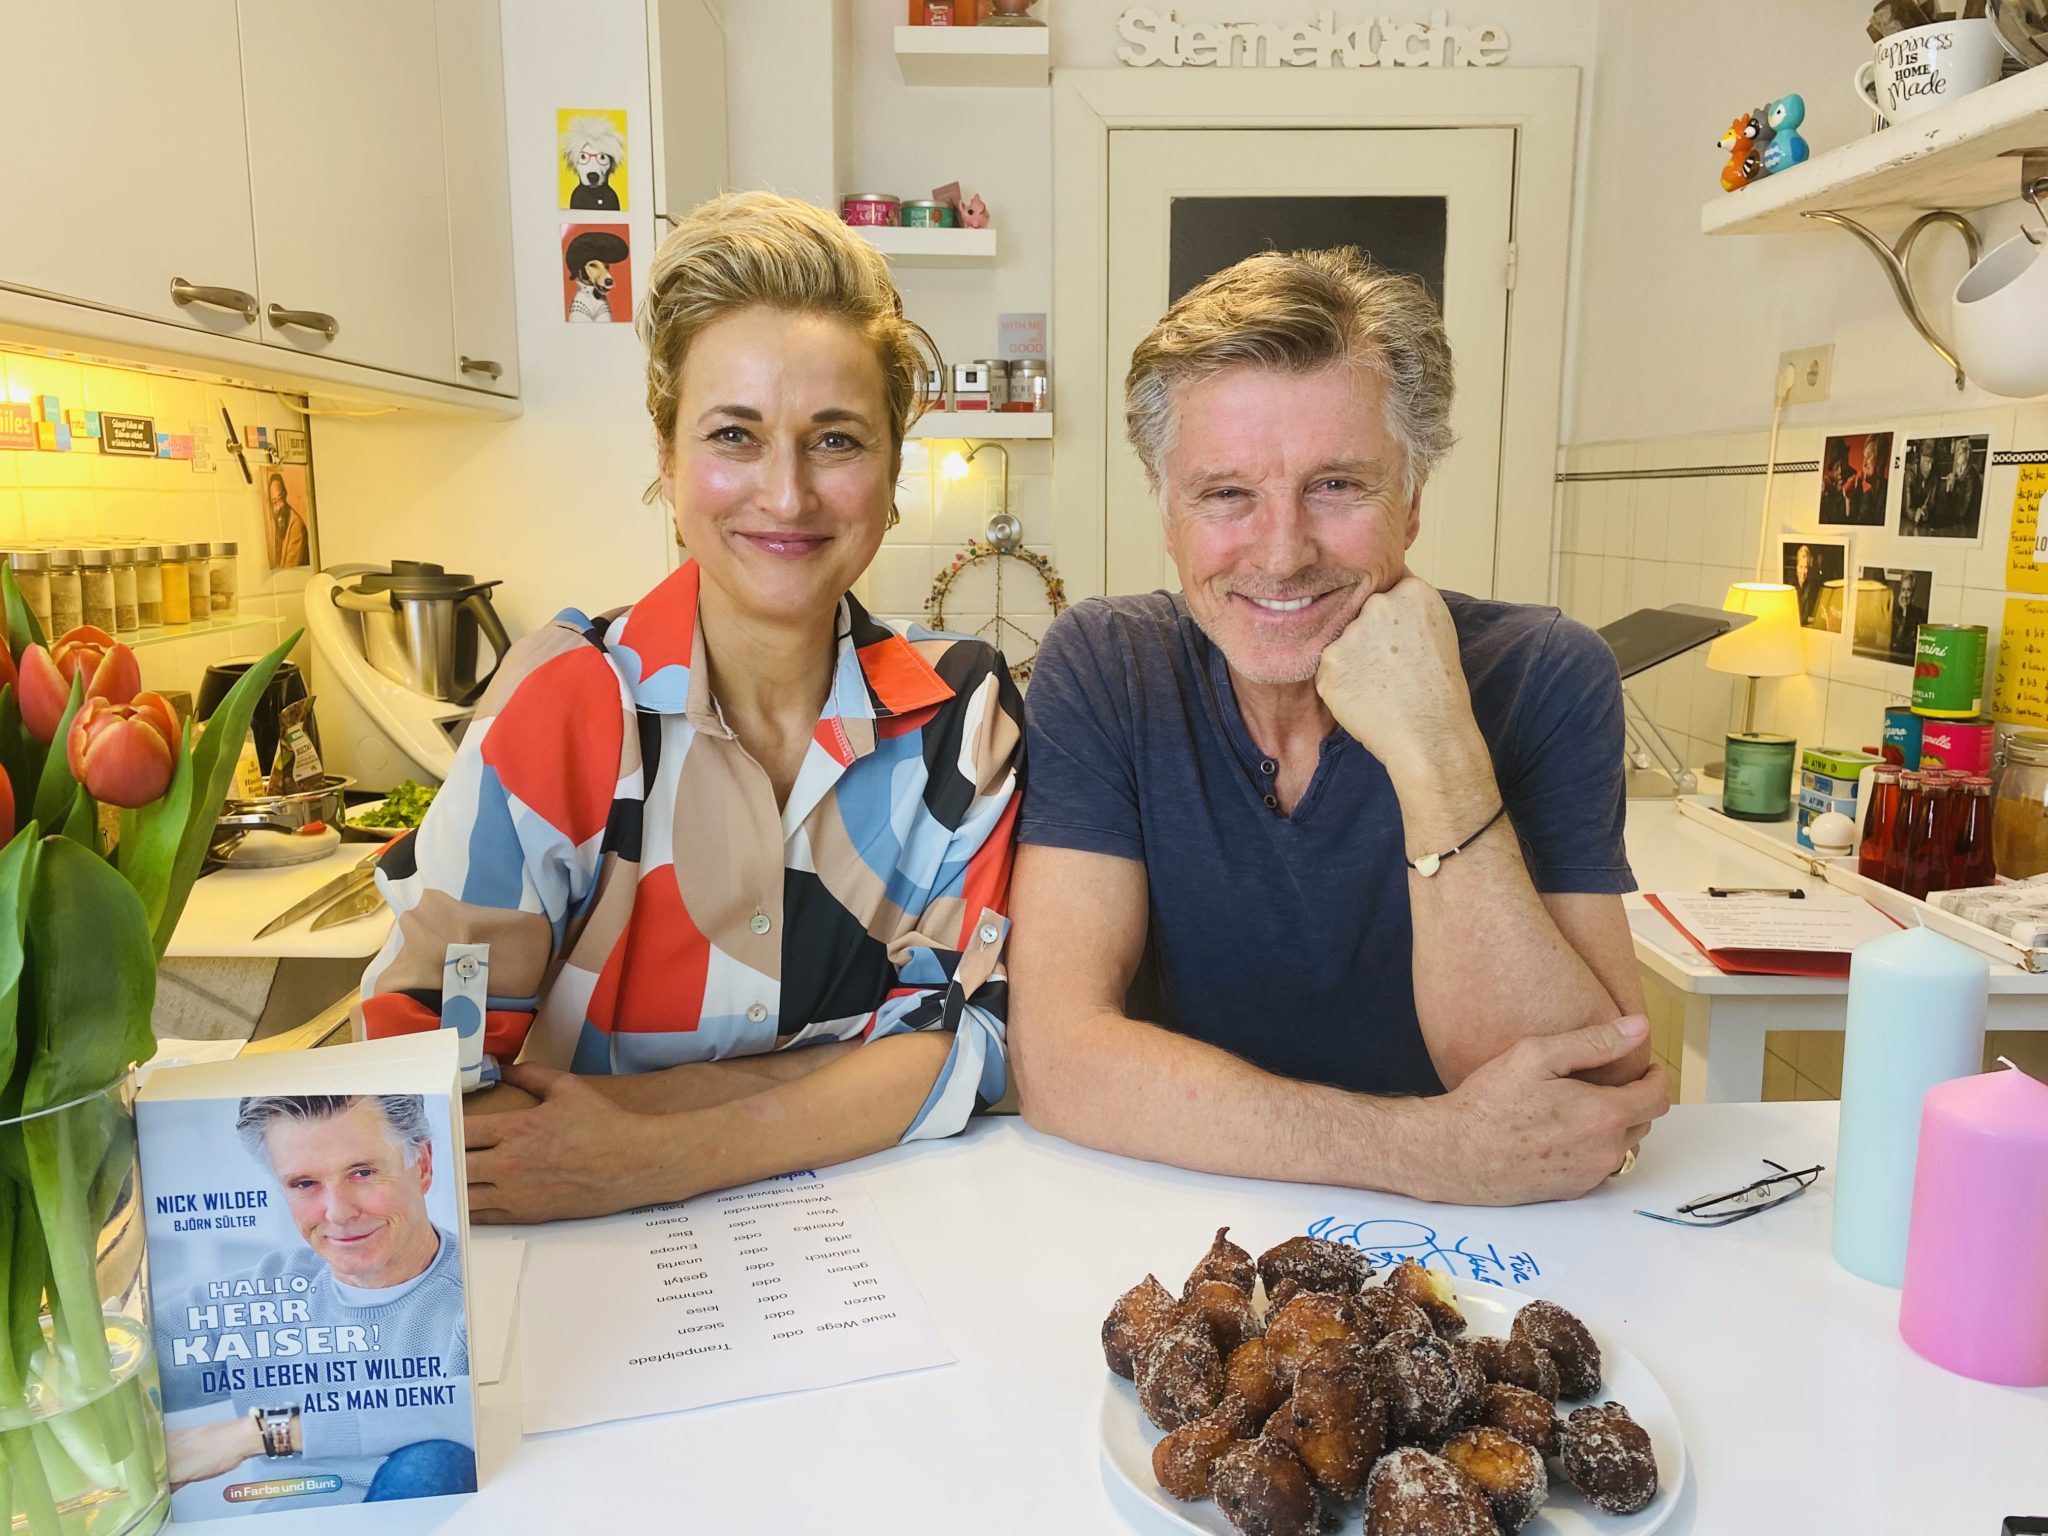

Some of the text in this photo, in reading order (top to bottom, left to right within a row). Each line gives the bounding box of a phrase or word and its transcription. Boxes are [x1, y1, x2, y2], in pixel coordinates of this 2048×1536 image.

[1905, 52, 1919, 66] IS
[1895, 64, 1931, 82] HOME
[1887, 69, 1947, 111] Made
[1008, 343, 1044, 354] GOOD
[716, 1192, 745, 1204] oder
[747, 1186, 795, 1200] halbvoll
[796, 1182, 825, 1194] Glas
[156, 1190, 269, 1214] NICK WILDER
[173, 1214, 257, 1232] BJÖRN SÜLTER
[645, 1216, 689, 1227] Ostern
[667, 1207, 839, 1239] Wein oder Bier
[649, 1220, 845, 1255] Amerika oder Europa
[656, 1233, 853, 1271] artig oder unartig
[744, 1261, 775, 1272] oder
[208, 1275, 317, 1299] HALLO,
[656, 1261, 869, 1303] geben oder nehmen
[663, 1271, 709, 1288] gestylt
[686, 1277, 878, 1315] laut oder leise
[186, 1299, 311, 1331] HERR
[677, 1293, 886, 1335] duzen oder siezen
[172, 1324, 382, 1366] KAISER!
[628, 1312, 897, 1366] neue Wege oder Trampelpfade
[202, 1356, 448, 1393] DAS LEBEN IST WILDER,
[303, 1385, 456, 1414] ALS MAN DENKT
[229, 1477, 337, 1499] in Farbe und Bunt
